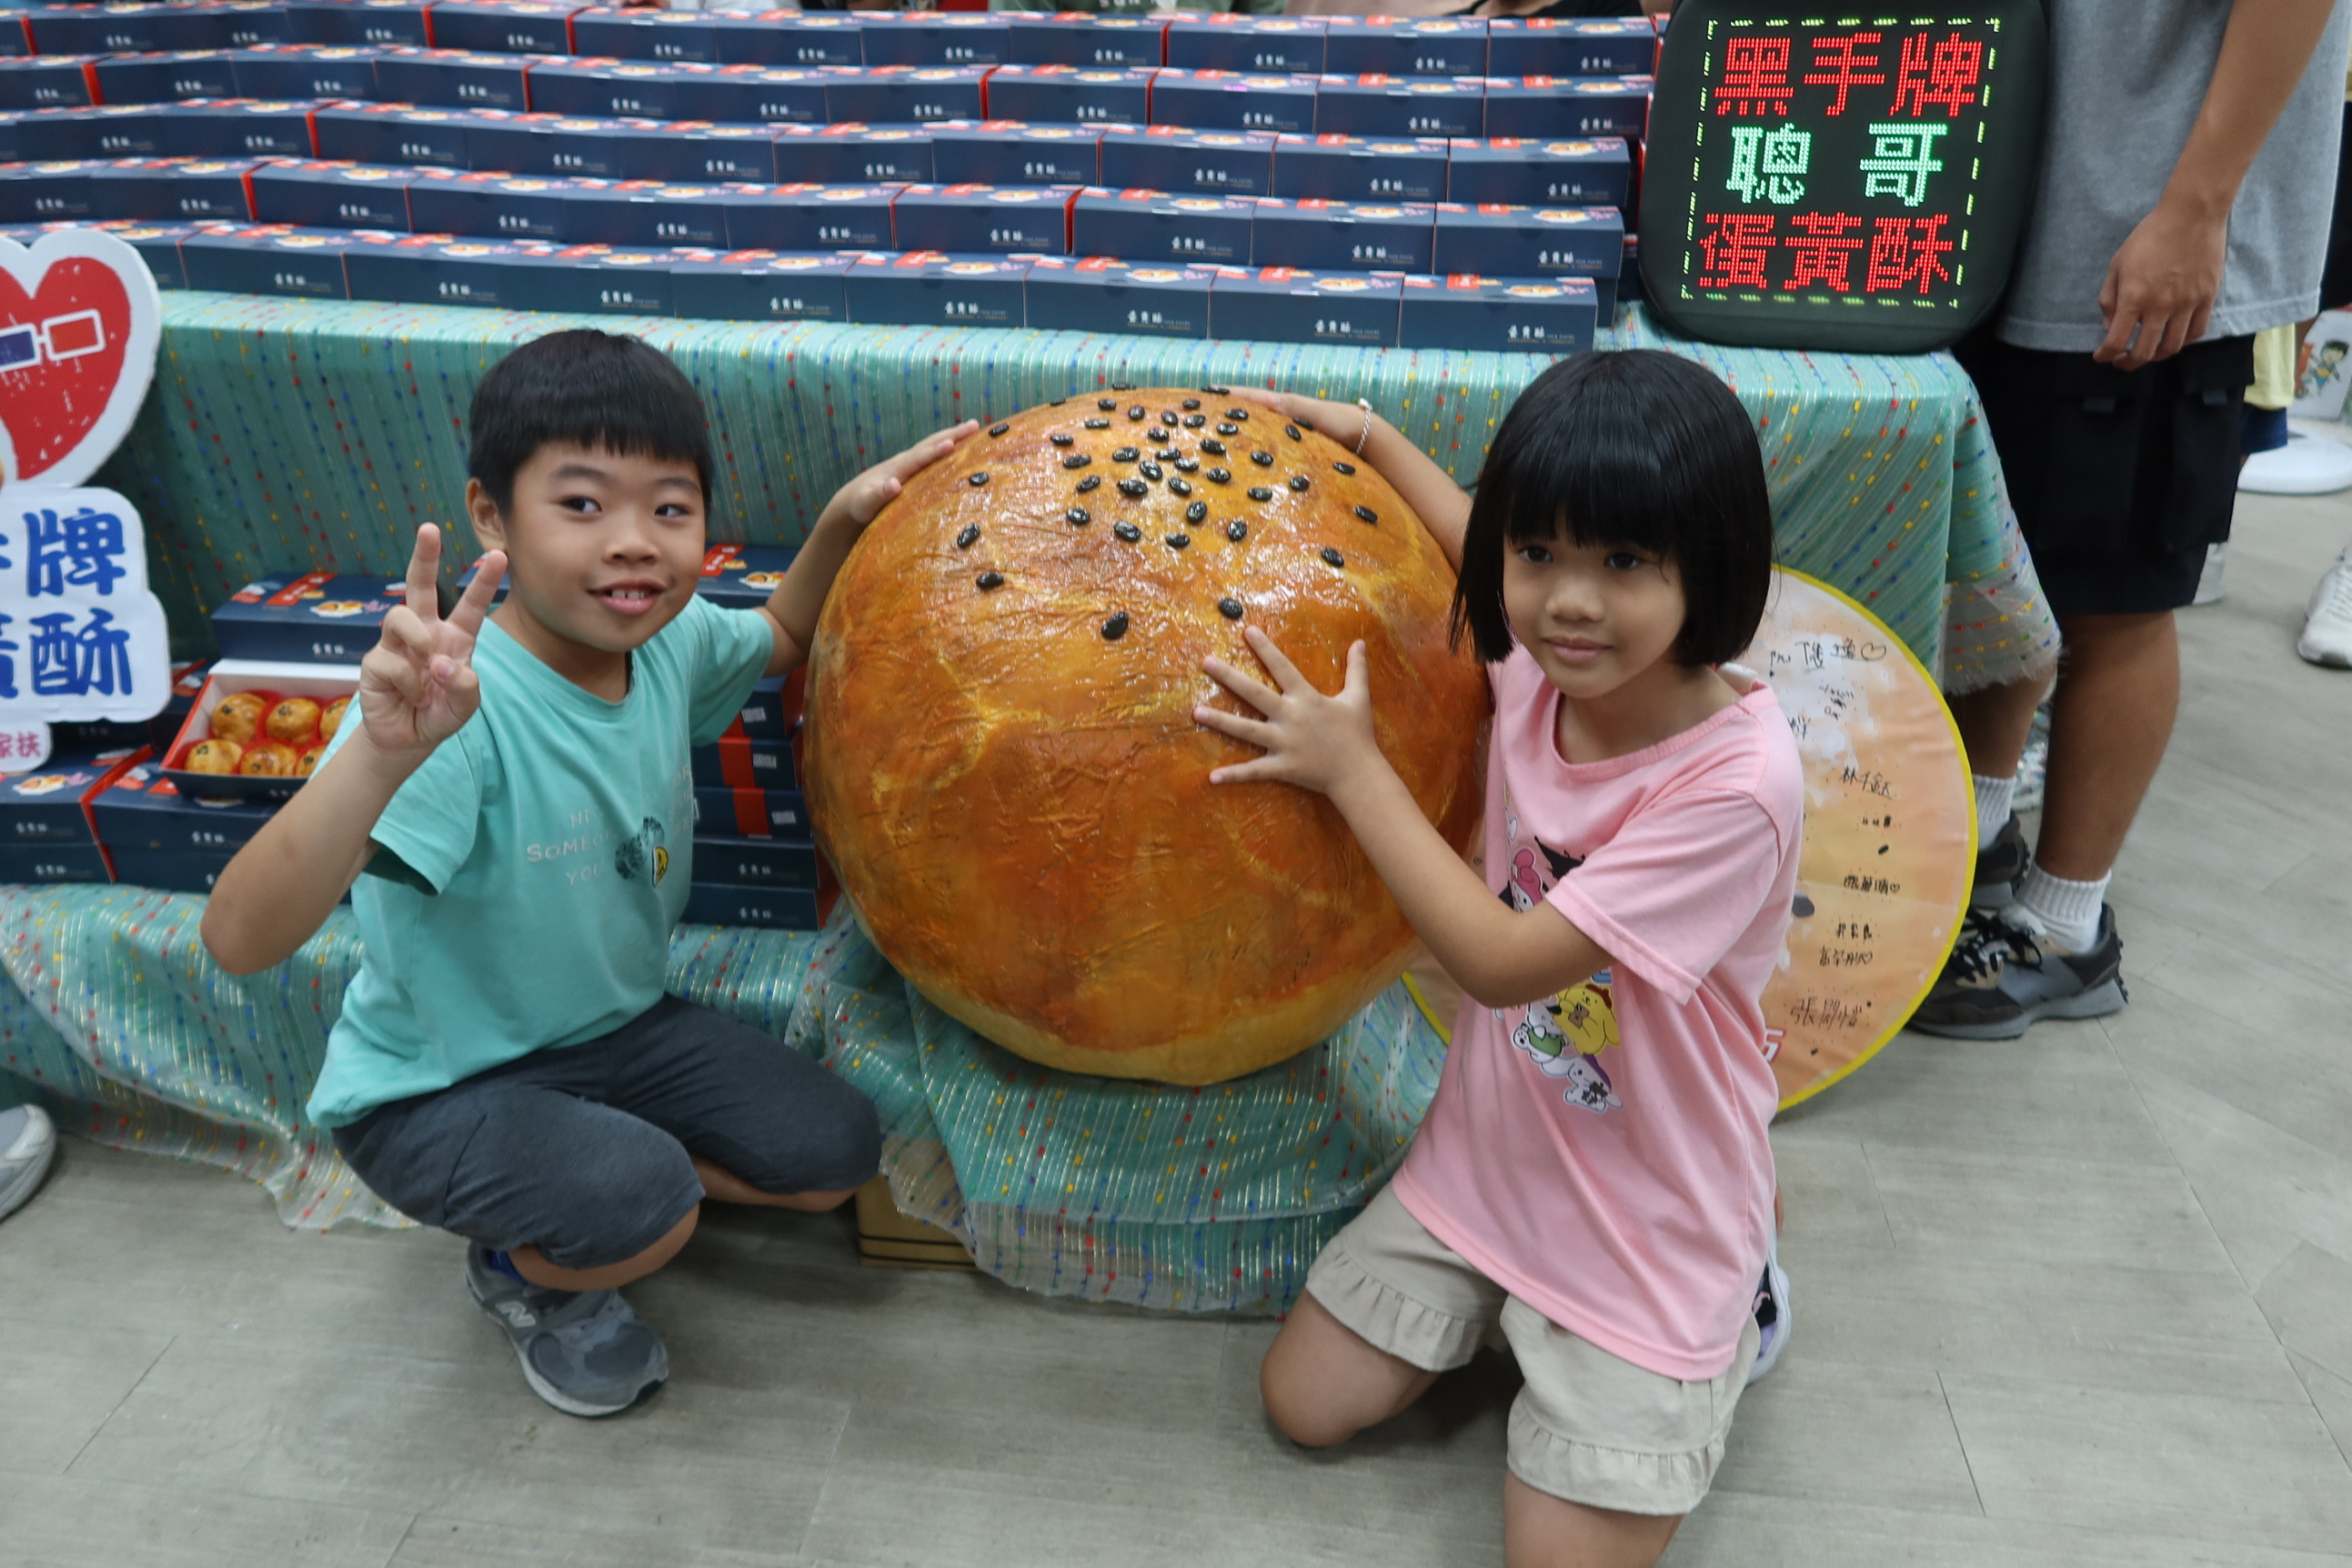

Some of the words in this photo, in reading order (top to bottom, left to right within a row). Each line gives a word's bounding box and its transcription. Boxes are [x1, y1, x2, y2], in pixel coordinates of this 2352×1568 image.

[1714, 32, 1983, 117] 黑手牌
[1698, 212, 1954, 294] 蛋黃酥
[0, 507, 127, 598] 牌
